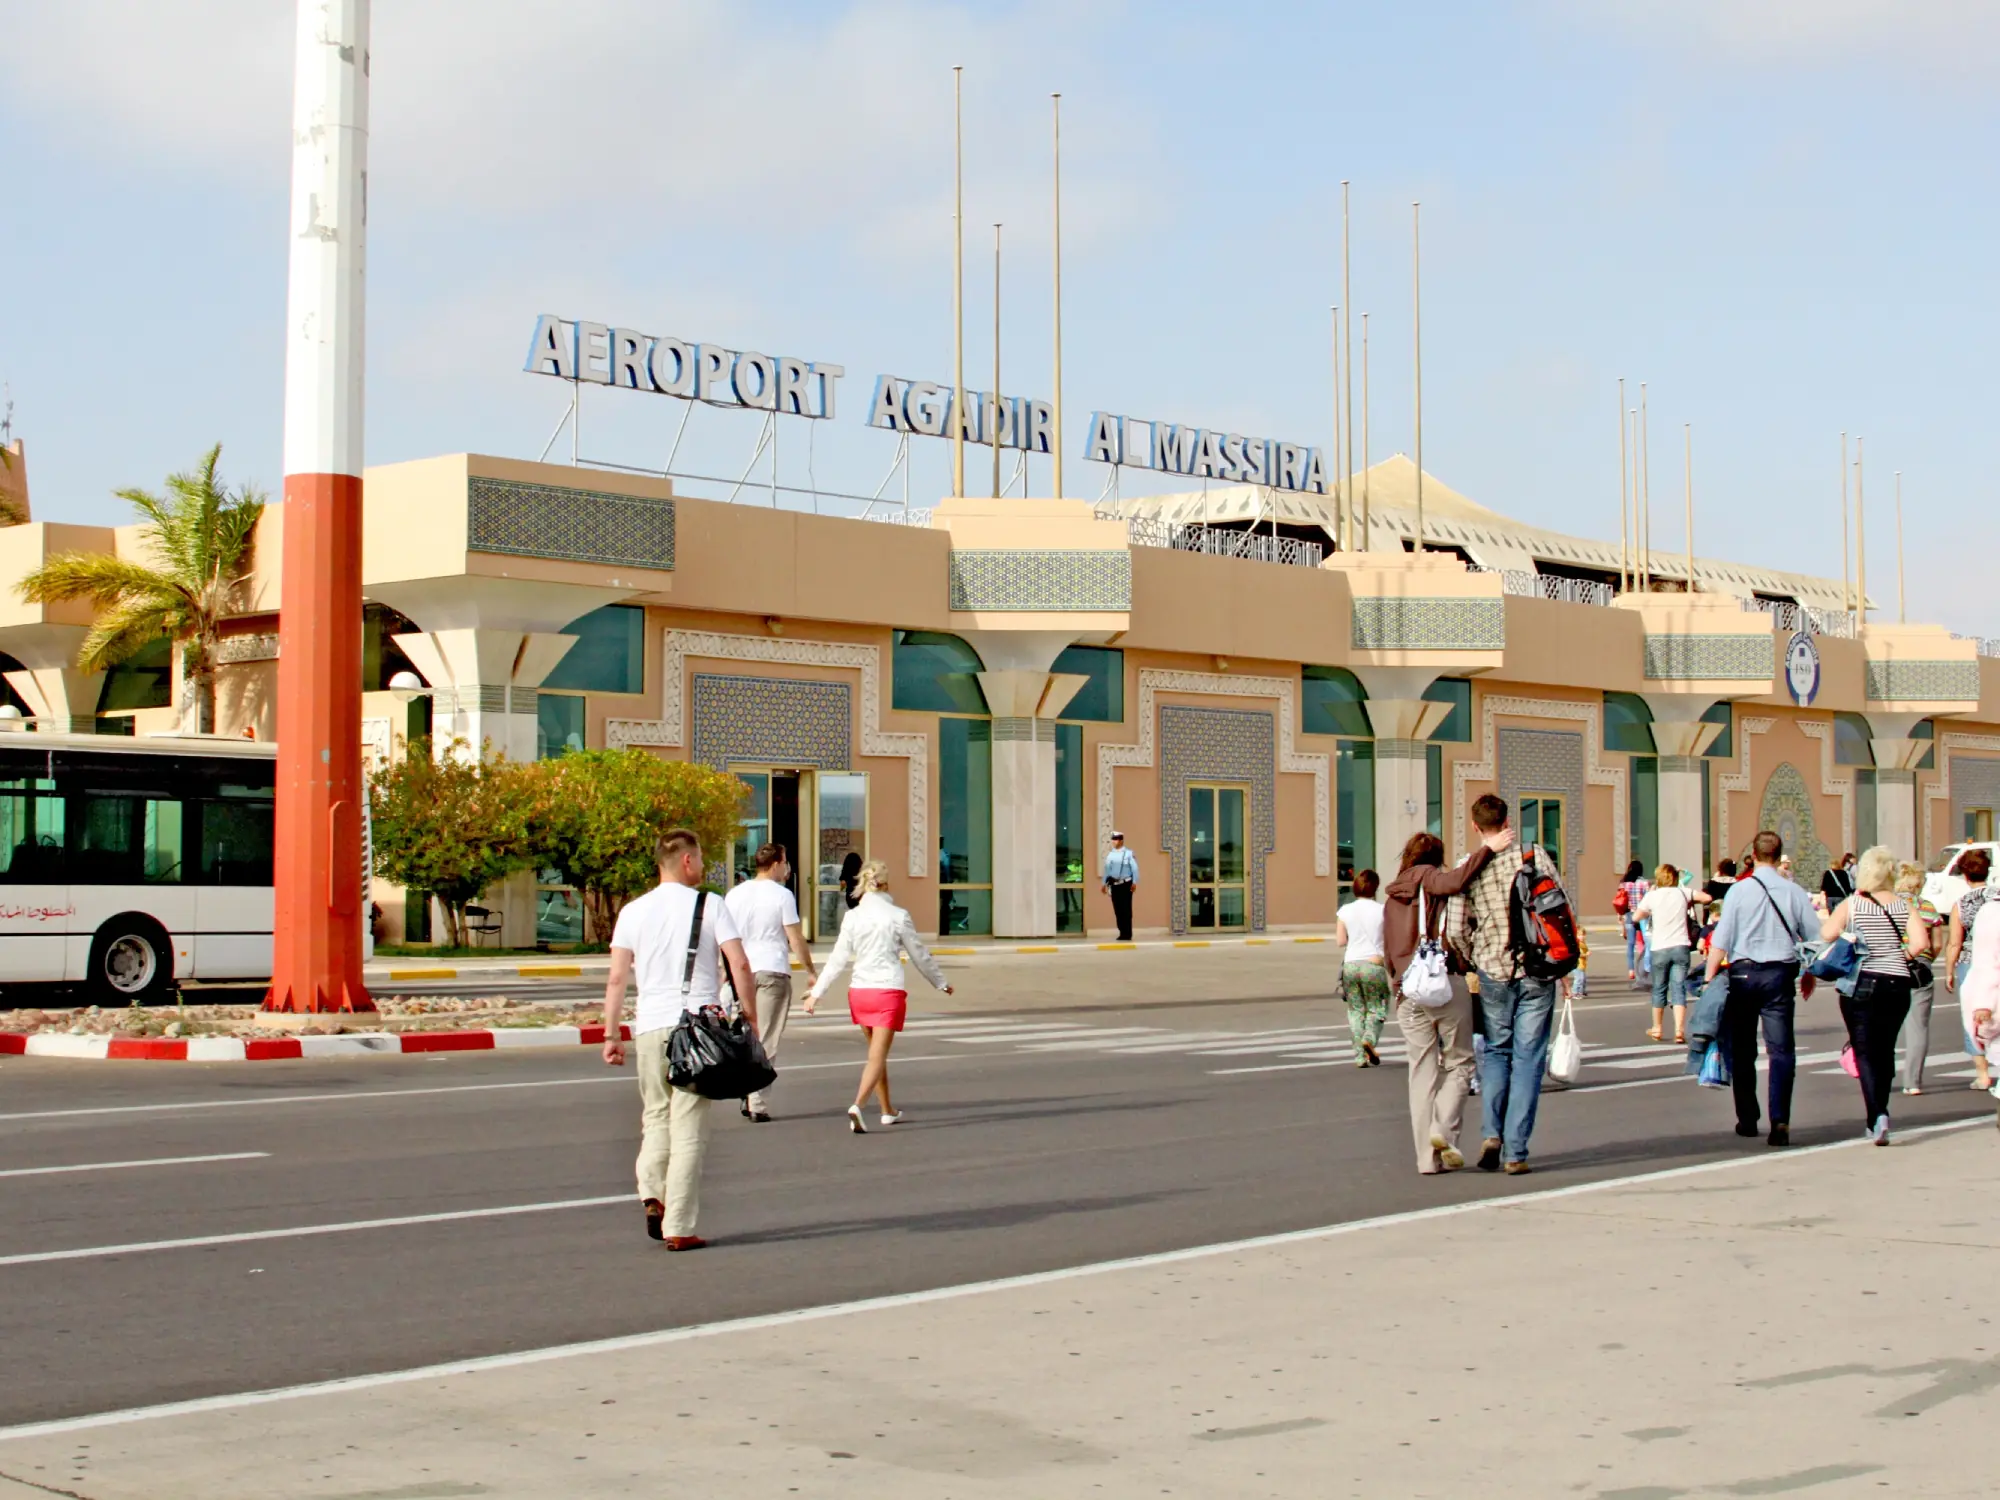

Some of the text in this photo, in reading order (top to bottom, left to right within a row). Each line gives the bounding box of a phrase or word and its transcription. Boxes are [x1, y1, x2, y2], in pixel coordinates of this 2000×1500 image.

[523, 314, 1328, 495] AEROPORT AGADIR AL MASSIRA
